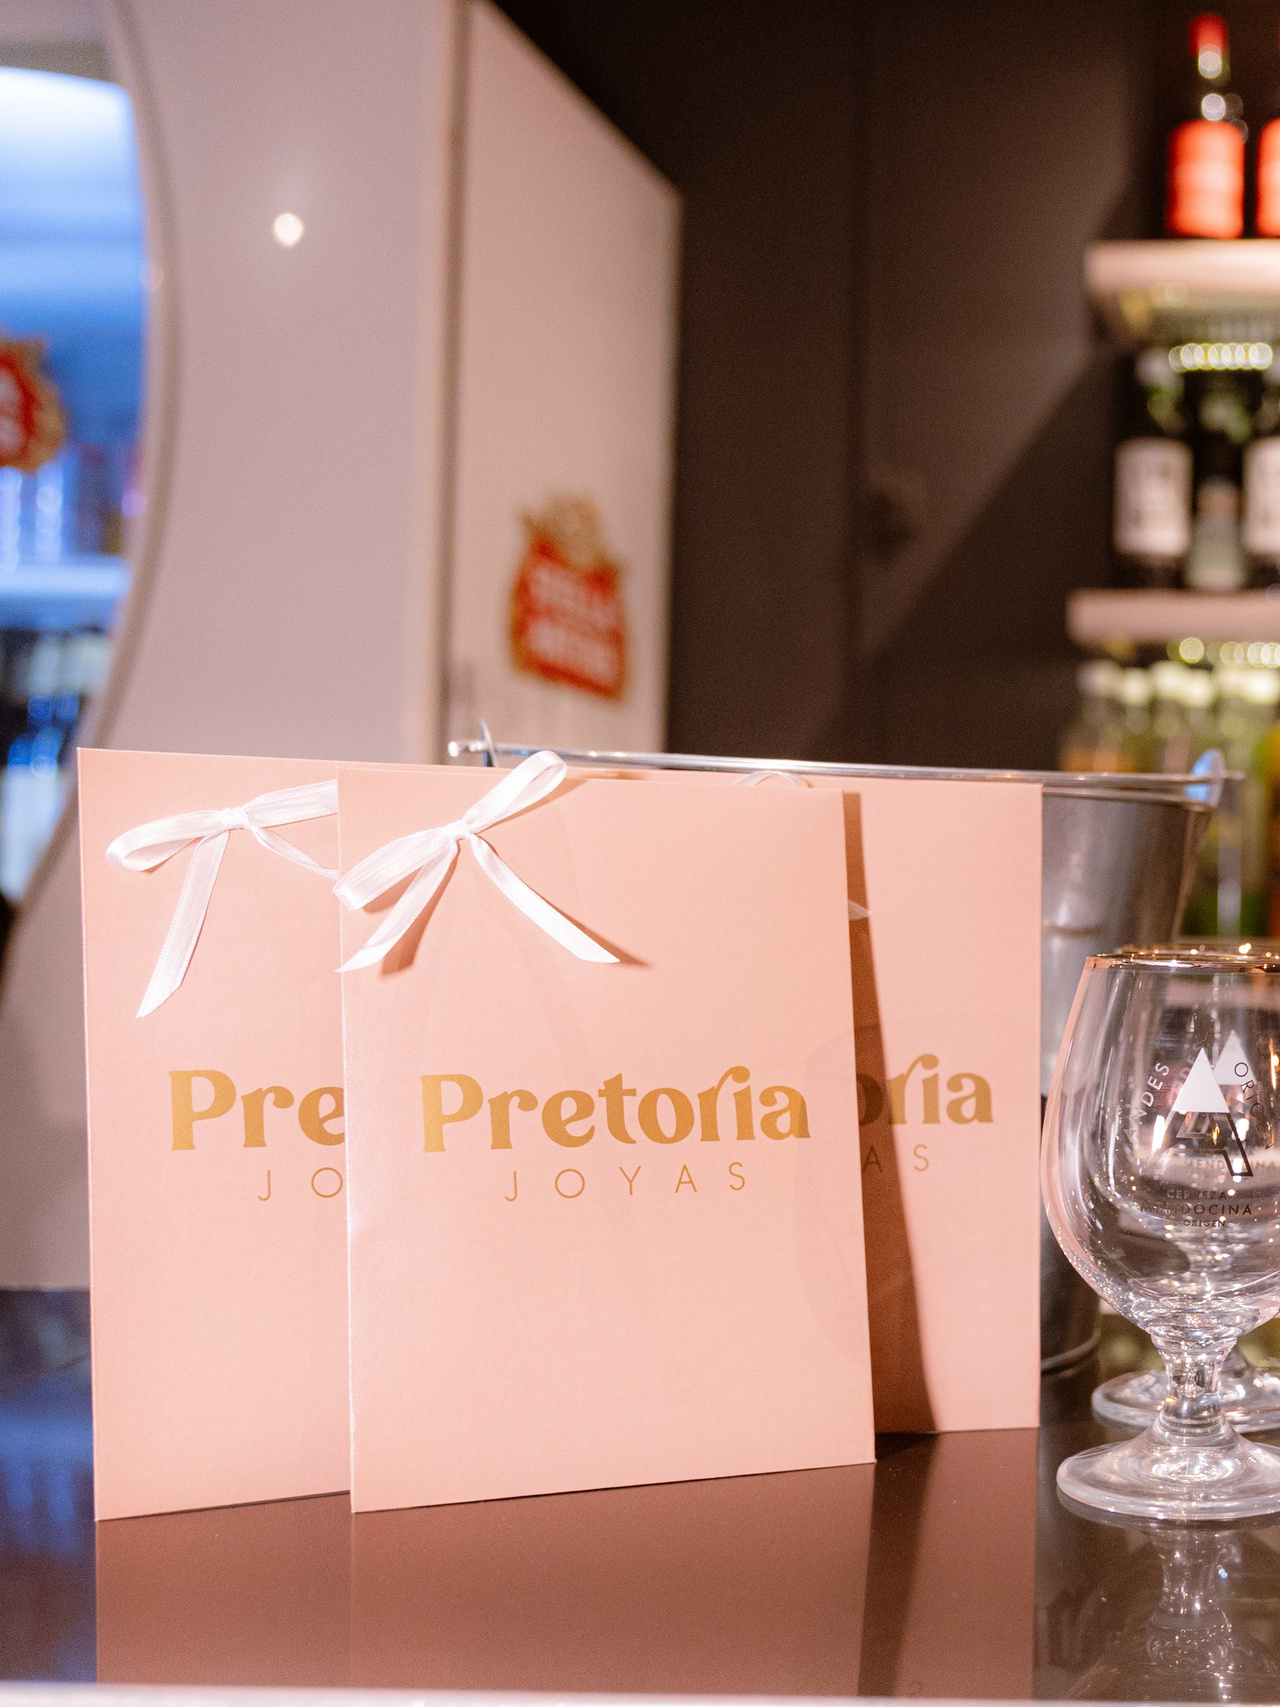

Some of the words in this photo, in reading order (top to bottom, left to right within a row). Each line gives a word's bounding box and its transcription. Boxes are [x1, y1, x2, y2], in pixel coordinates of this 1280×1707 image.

[420, 1065, 811, 1153] Pretoria
[257, 1167, 343, 1201] JO
[504, 1161, 746, 1202] JOYAS
[1182, 1219, 1226, 1228] ORIGEN
